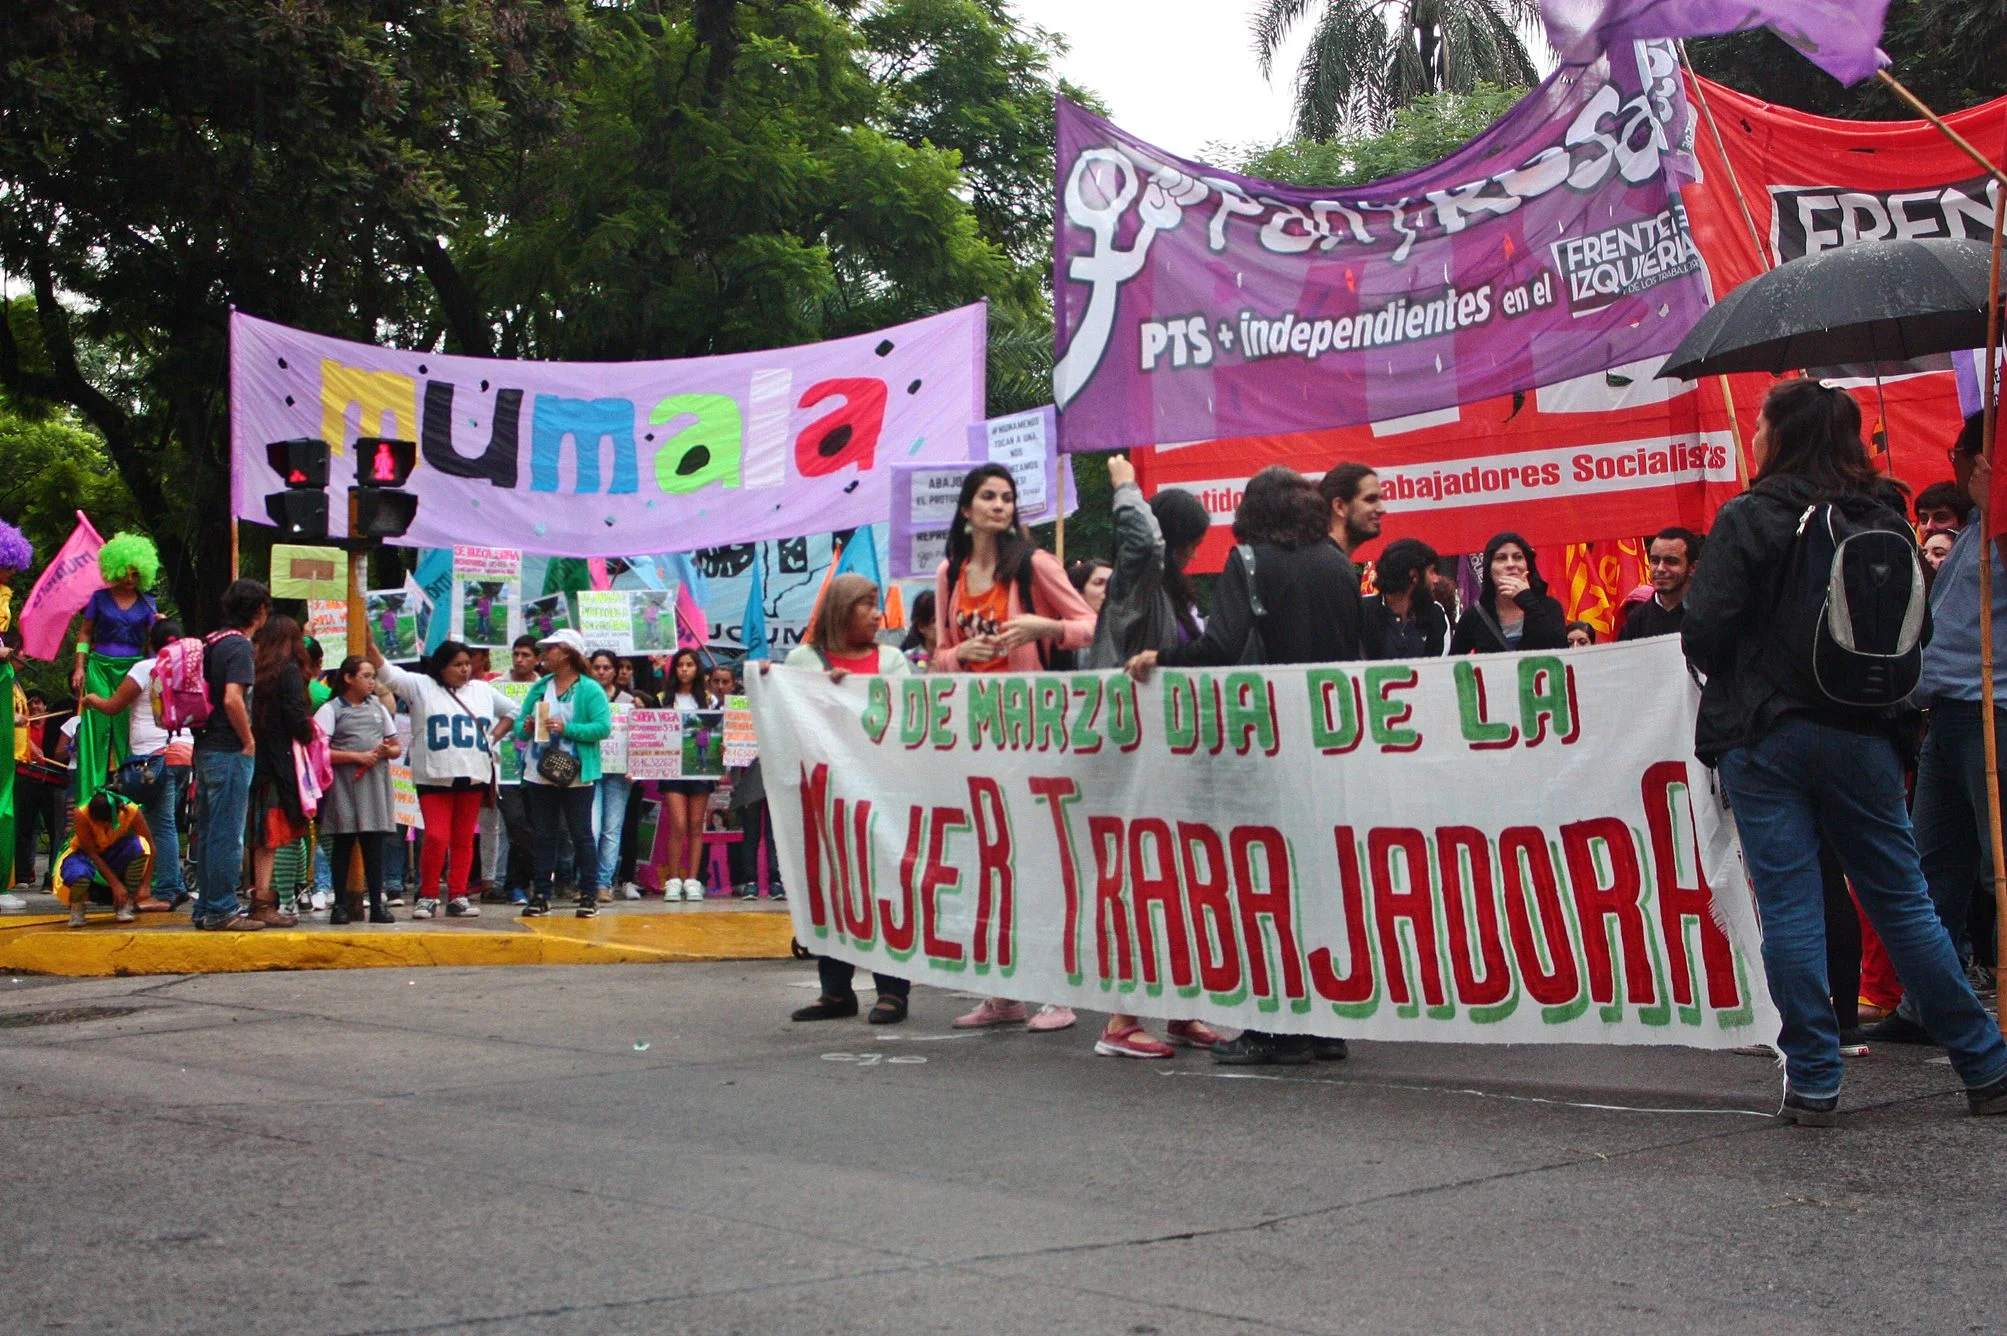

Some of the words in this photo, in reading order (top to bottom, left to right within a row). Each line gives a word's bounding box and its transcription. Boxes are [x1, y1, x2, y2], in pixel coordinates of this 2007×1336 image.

[1566, 209, 1671, 271] FRENTE
[1140, 315, 1213, 371] PTS
[1239, 284, 1492, 359] independientes
[1503, 287, 1529, 316] en
[1530, 272, 1552, 305] el
[318, 356, 890, 496] mumala
[901, 676, 958, 751] DE
[966, 673, 1143, 755] MARZO
[1162, 671, 1281, 757] DIA
[1306, 664, 1424, 756] DE
[1453, 655, 1581, 750] LA
[799, 761, 1017, 979] MUJER
[1028, 760, 1755, 1030] TRABAJADORA
